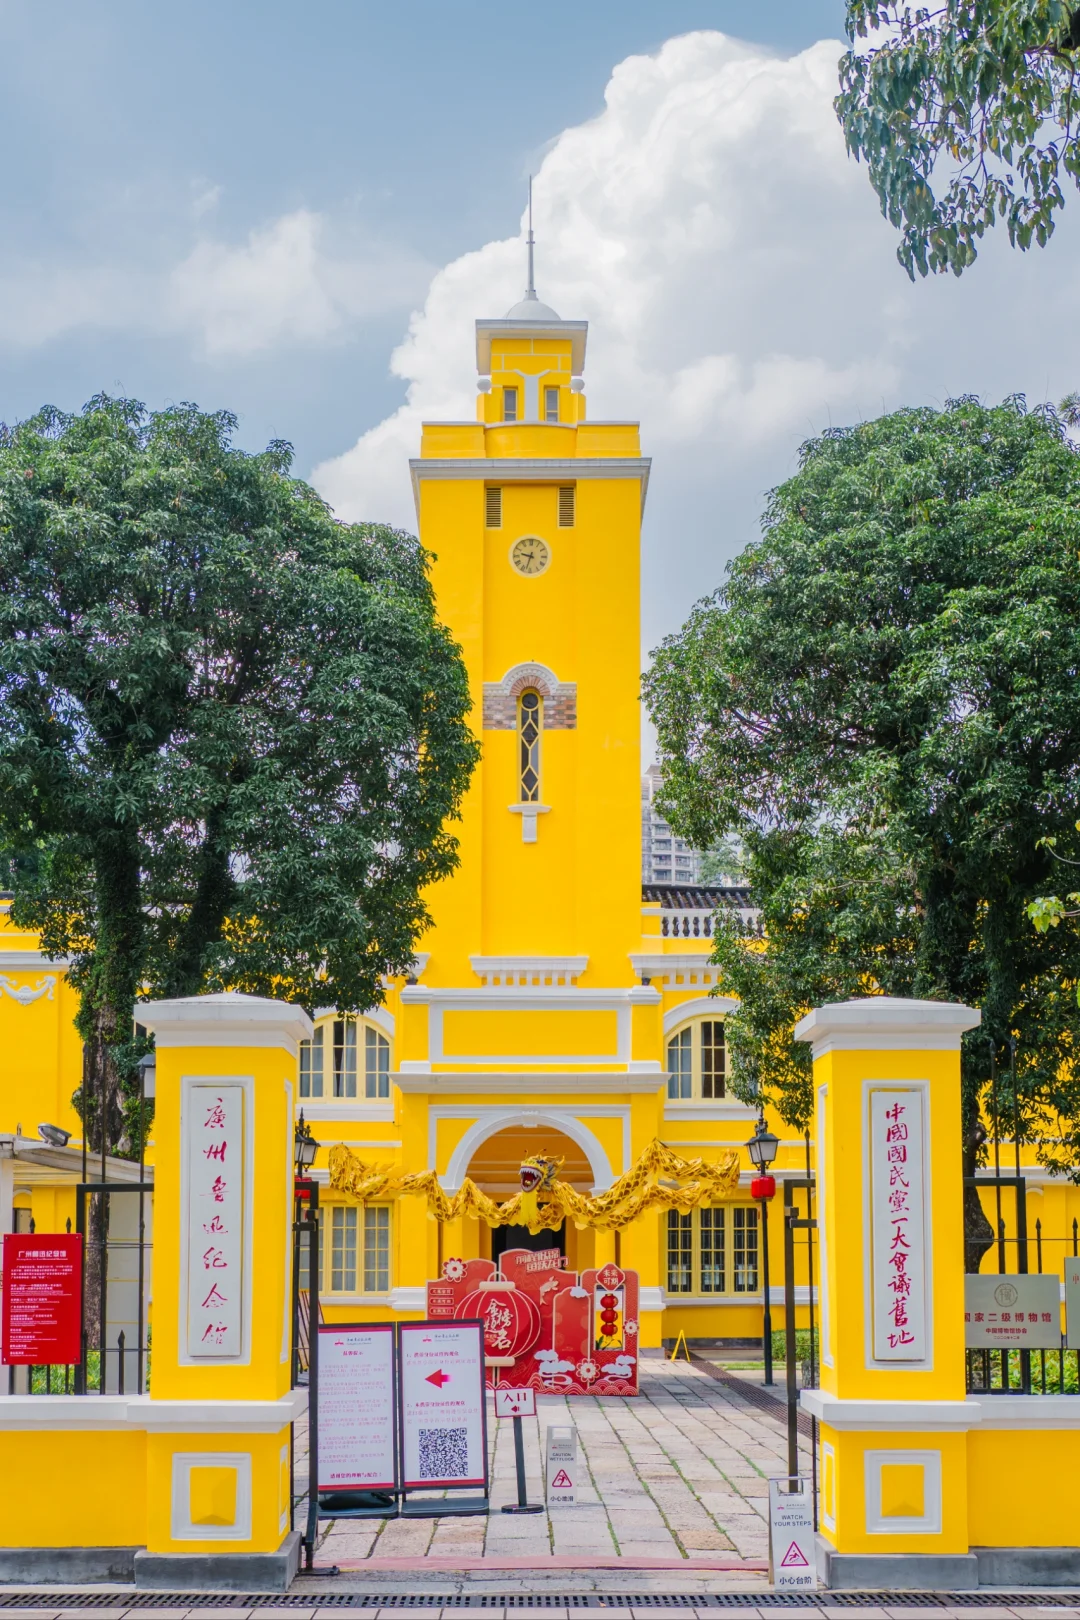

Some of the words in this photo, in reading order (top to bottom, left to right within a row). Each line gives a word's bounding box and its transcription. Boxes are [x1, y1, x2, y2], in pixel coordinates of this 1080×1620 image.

[504, 1392, 526, 1402] 入口
[779, 1576, 812, 1584] 小心台阶
